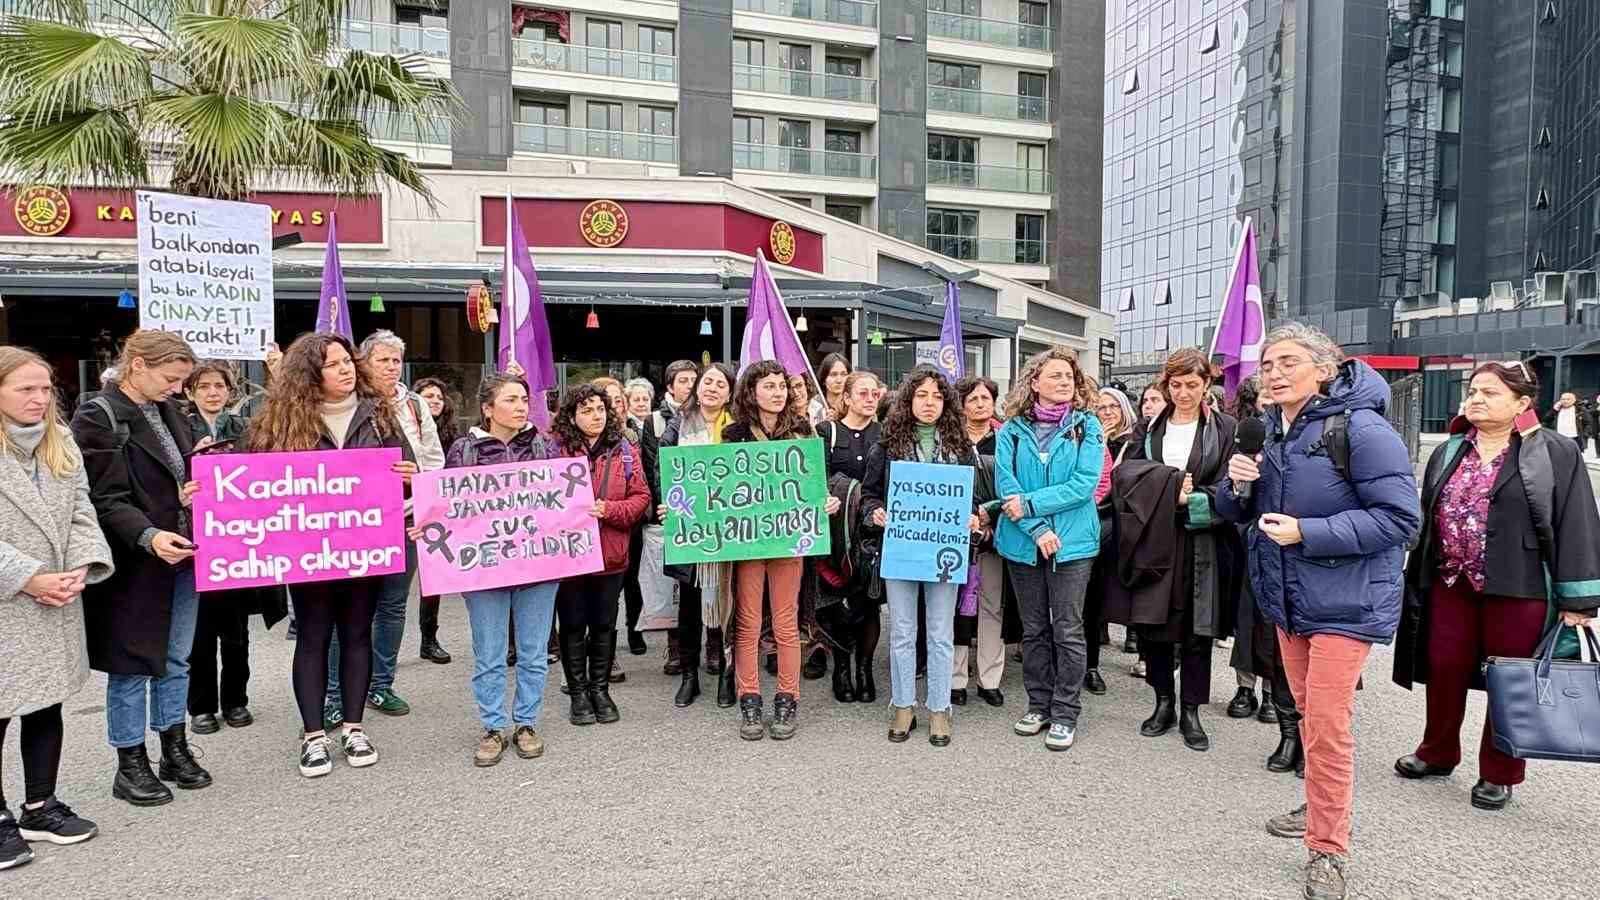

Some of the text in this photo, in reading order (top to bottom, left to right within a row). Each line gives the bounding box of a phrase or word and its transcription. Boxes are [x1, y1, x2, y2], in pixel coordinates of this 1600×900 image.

[151, 225, 260, 255] balkondan
[149, 255, 254, 282] atabilseydi
[150, 277, 260, 302] bu bir KADIN
[148, 300, 253, 326] CİNAYETİ
[213, 463, 362, 502] Kadınlar
[440, 466, 554, 497] HAYATINI
[892, 480, 964, 498] yaşasın
[445, 488, 566, 519] SAVUNMAK
[890, 500, 961, 526] feminist
[204, 502, 383, 546] hayatlarına
[486, 514, 538, 538] SUÇ
[887, 524, 969, 545] mücadelemiz
[208, 536, 401, 582] sahip çıkıyor
